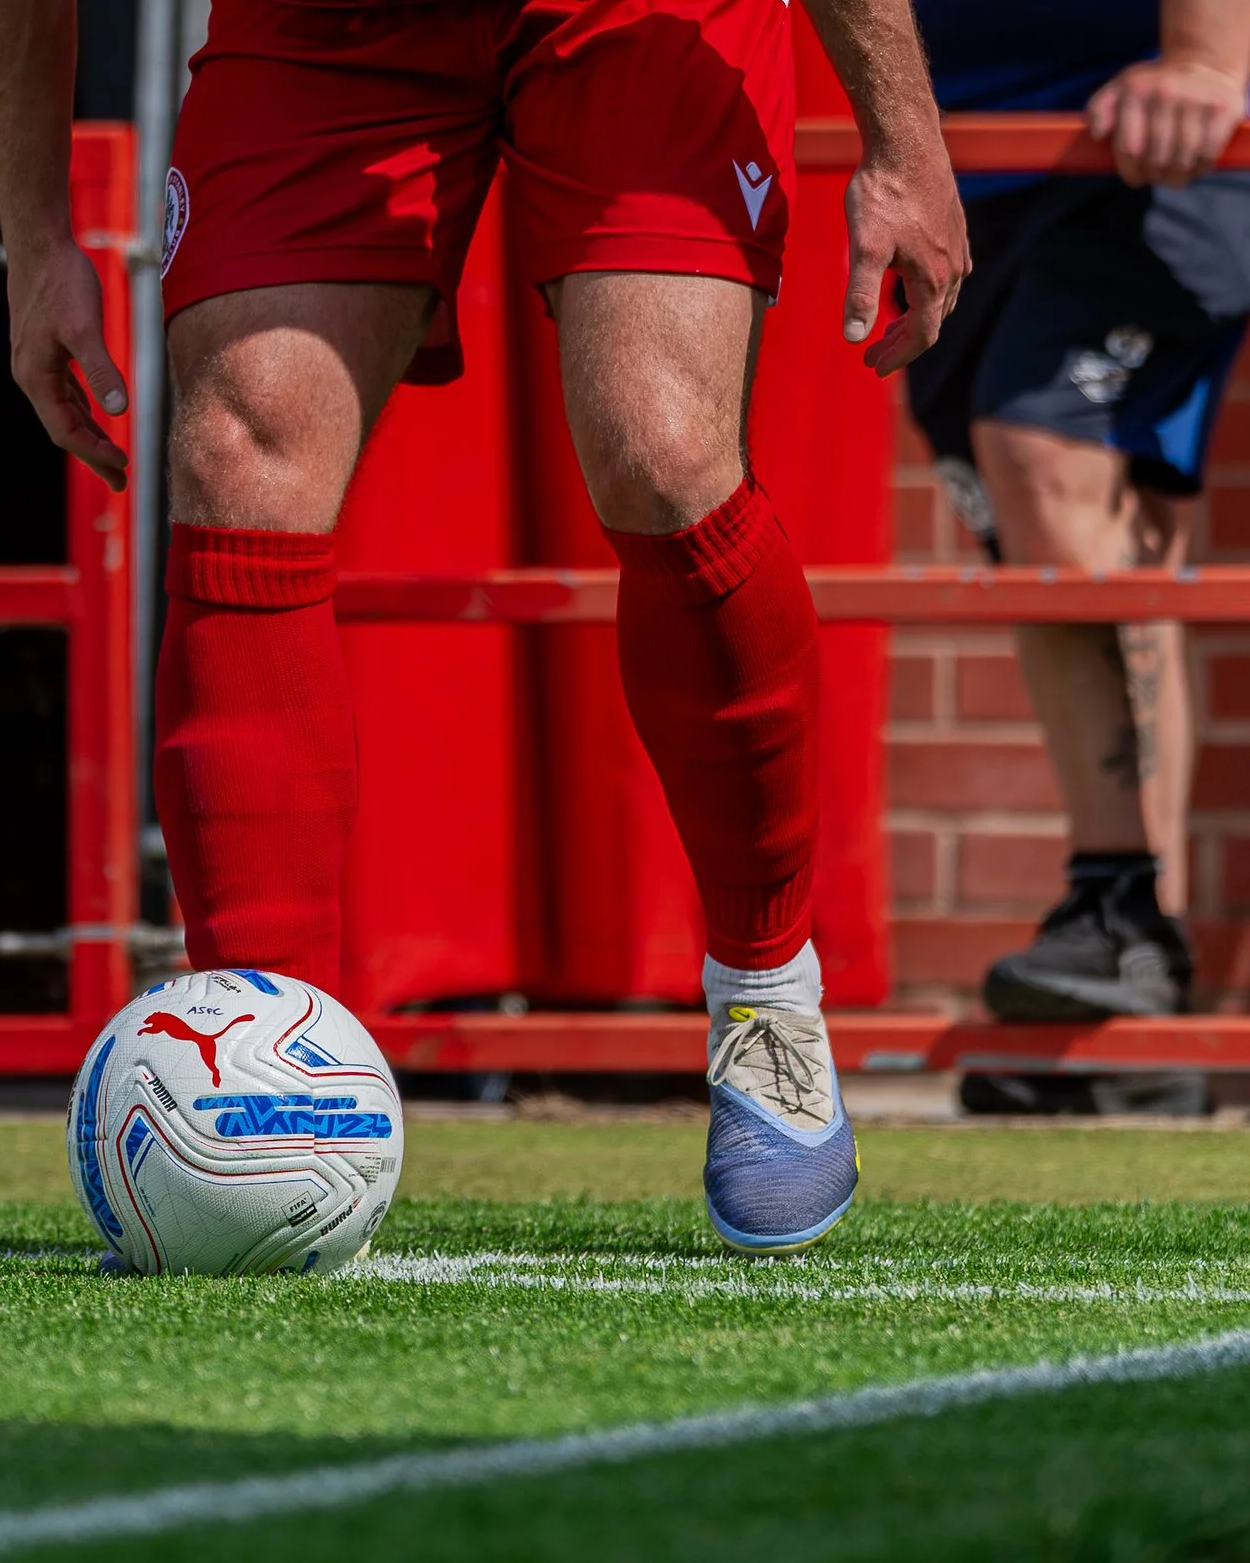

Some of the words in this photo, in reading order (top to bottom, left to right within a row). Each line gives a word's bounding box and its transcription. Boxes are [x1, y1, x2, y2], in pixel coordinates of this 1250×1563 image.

[147, 1075, 179, 1113] PUMA
[289, 1199, 307, 1213] FIFA
[320, 1204, 354, 1237] PUMA
